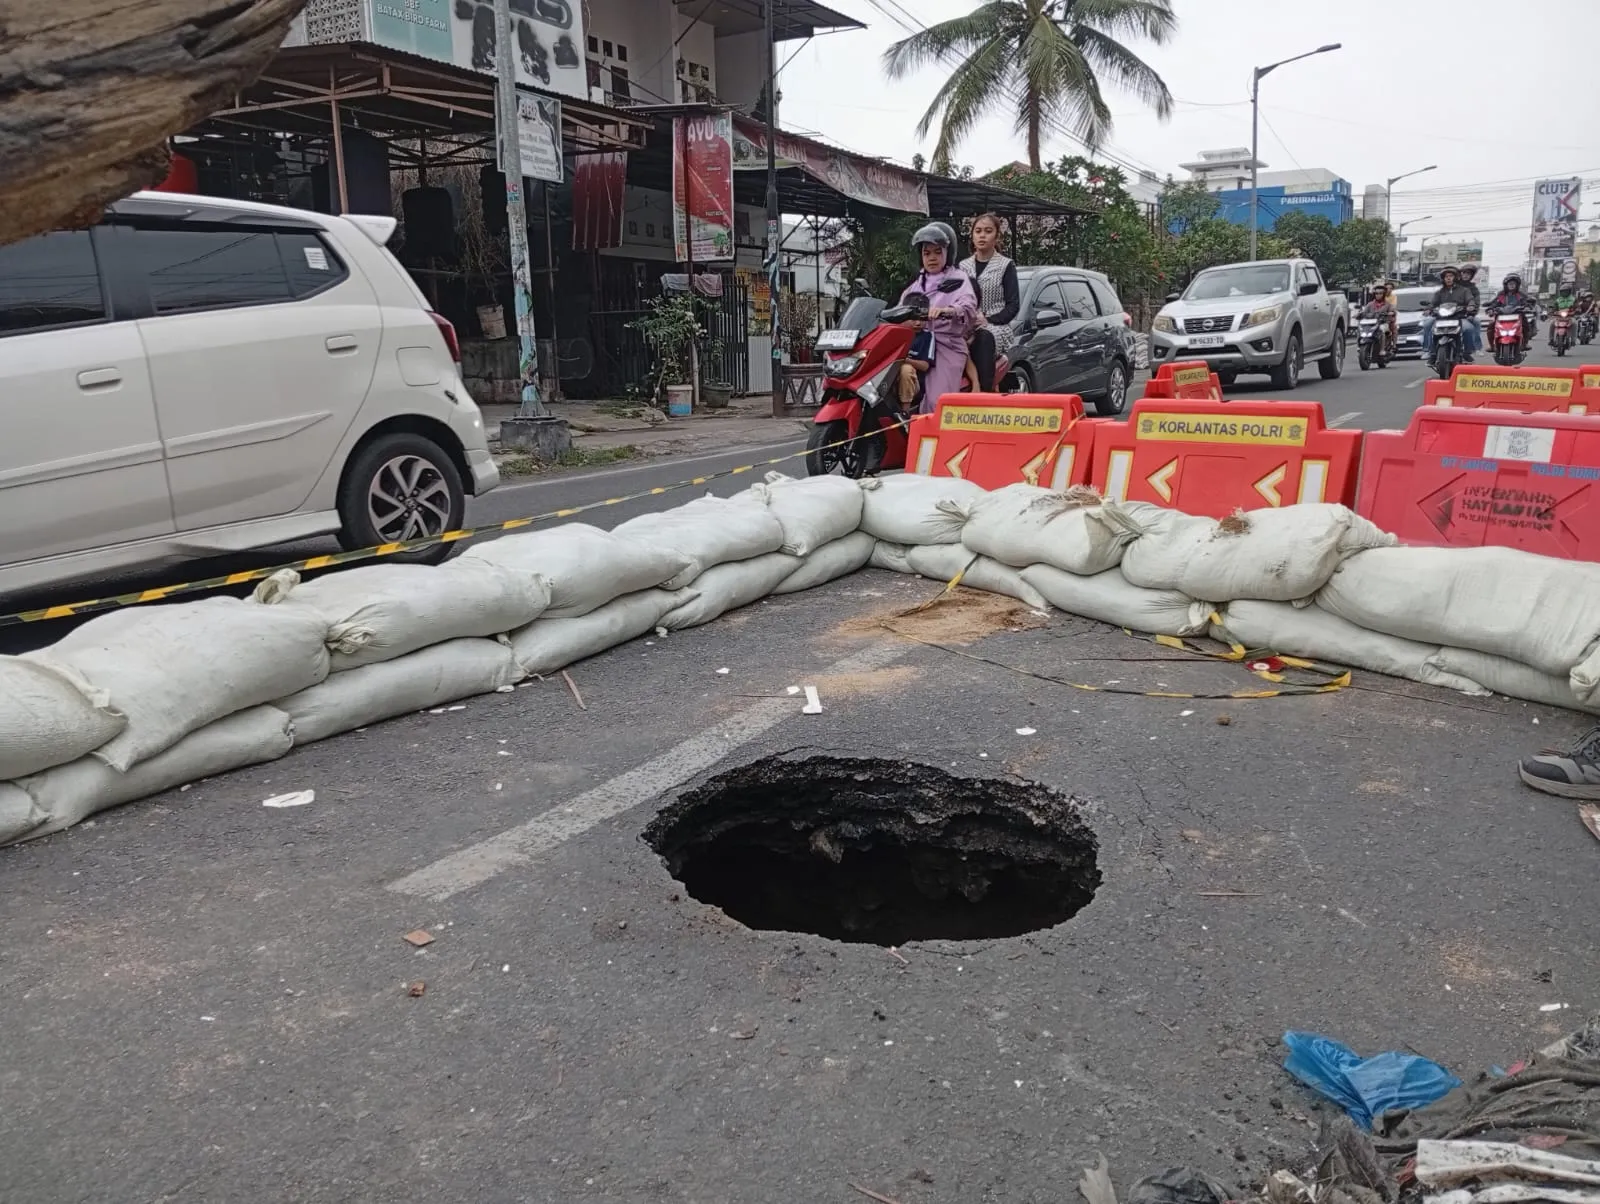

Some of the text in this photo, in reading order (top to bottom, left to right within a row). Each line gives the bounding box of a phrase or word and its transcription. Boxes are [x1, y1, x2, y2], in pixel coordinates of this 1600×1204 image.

[405, 11, 424, 25] BIRD
[425, 17, 447, 31] FARM
[1471, 379, 1557, 391] KORLANTAS POLRI
[957, 413, 1045, 427] KORLANTAS POLRI
[1158, 421, 1283, 438] KORLANTAS POLRI
